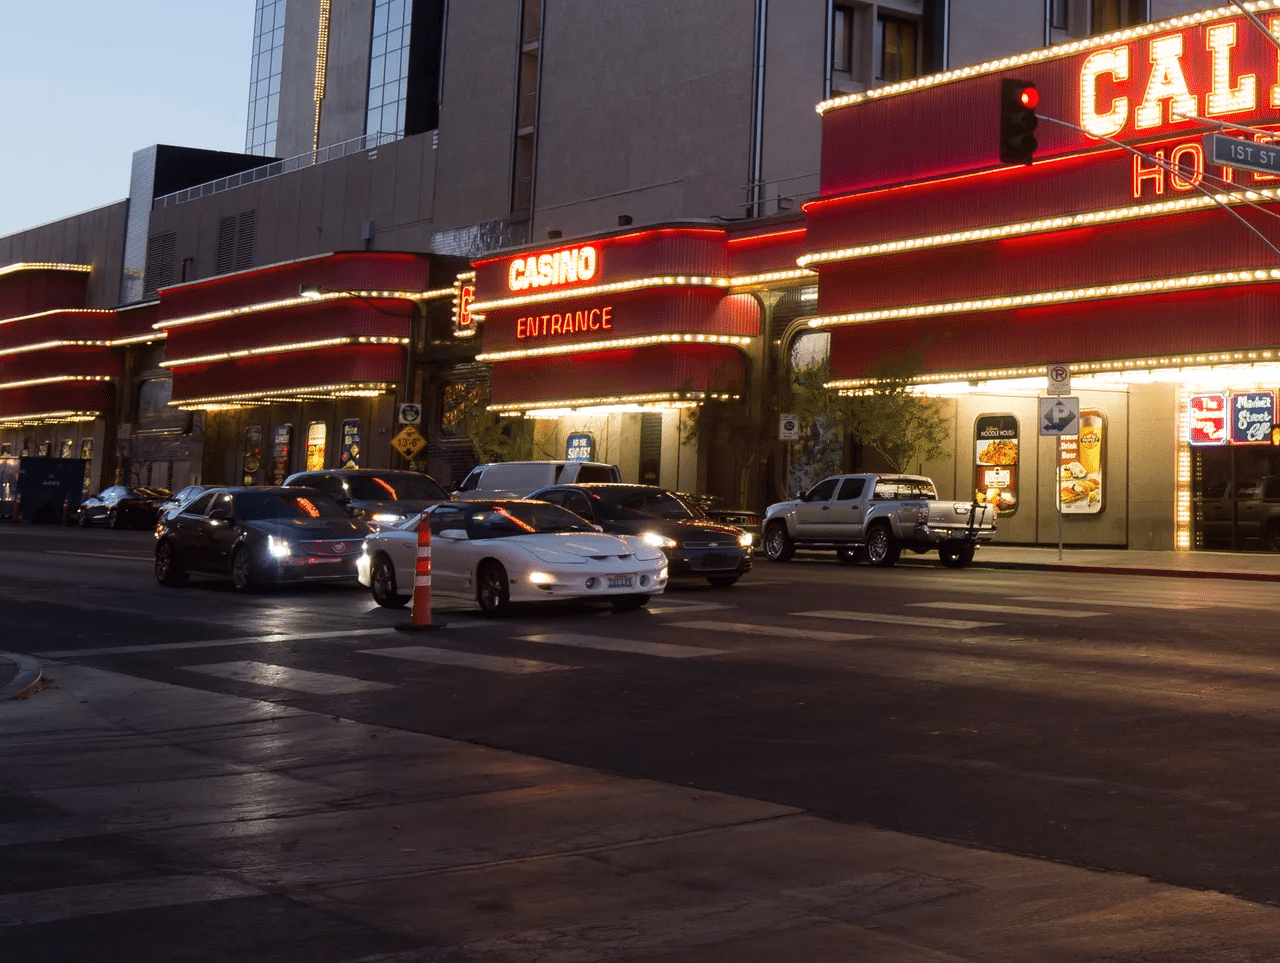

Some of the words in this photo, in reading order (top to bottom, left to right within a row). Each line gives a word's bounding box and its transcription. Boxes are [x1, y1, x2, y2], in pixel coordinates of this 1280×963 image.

[1230, 144, 1254, 161] 1ST
[1259, 151, 1276, 166] ST
[508, 246, 597, 292] CASINO
[516, 306, 613, 338] ENTRANCE
[1061, 441, 1078, 451] Drink
[1061, 451, 1077, 460] Beer
